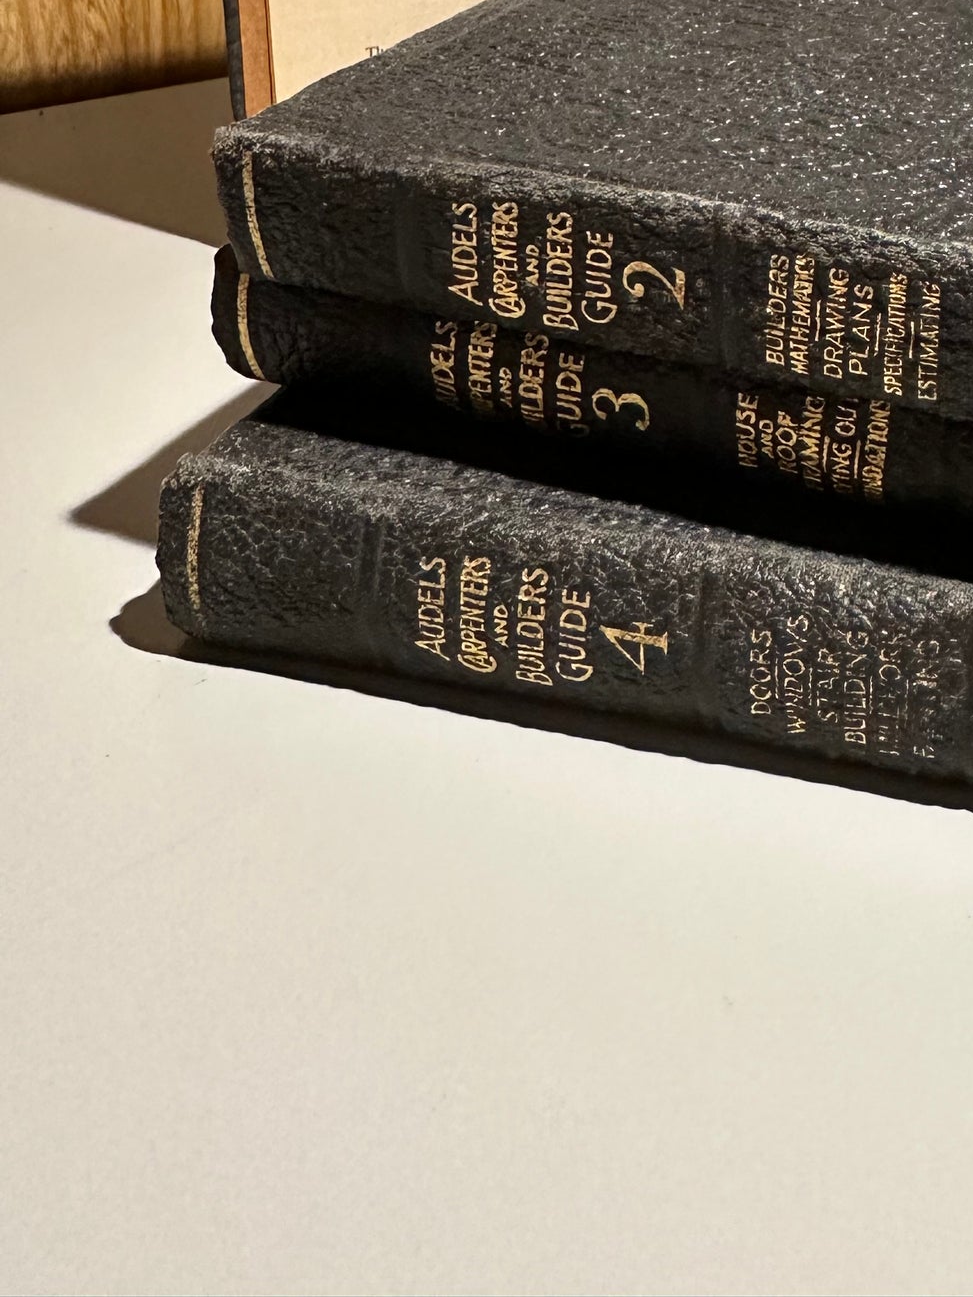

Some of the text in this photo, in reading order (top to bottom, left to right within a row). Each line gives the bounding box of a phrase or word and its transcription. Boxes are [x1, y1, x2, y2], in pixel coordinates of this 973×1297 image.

[448, 202, 483, 307] AUDELS
[488, 201, 526, 319] CARPENTERS
[523, 243, 540, 287] AND
[542, 211, 580, 331] BUILDERS
[581, 230, 618, 324] GUIDE
[622, 260, 686, 311] 2
[763, 254, 790, 367] BUILDERS
[789, 253, 815, 375] MATHEMATICS
[823, 267, 849, 380] DRAWING
[848, 283, 873, 376] PLANS
[884, 272, 908, 397] SPECIFICATIONS
[918, 281, 941, 401] ESTIMATING
[499, 366, 513, 408] AND
[592, 387, 650, 431] 3
[735, 392, 759, 468] HOUSE
[758, 418, 774, 459] AND
[776, 410, 799, 474] ROOF
[415, 555, 450, 661] AUDELS
[457, 554, 498, 674] CARPENTERS
[493, 604, 509, 648] AND
[515, 567, 553, 687] BUILDERS
[555, 588, 593, 682] GUIDE
[599, 621, 668, 675] 4
[750, 628, 772, 715] DOORS
[783, 614, 809, 734] WINDOWS
[816, 648, 841, 723] STAIR
[844, 630, 870, 745] BUILDING
